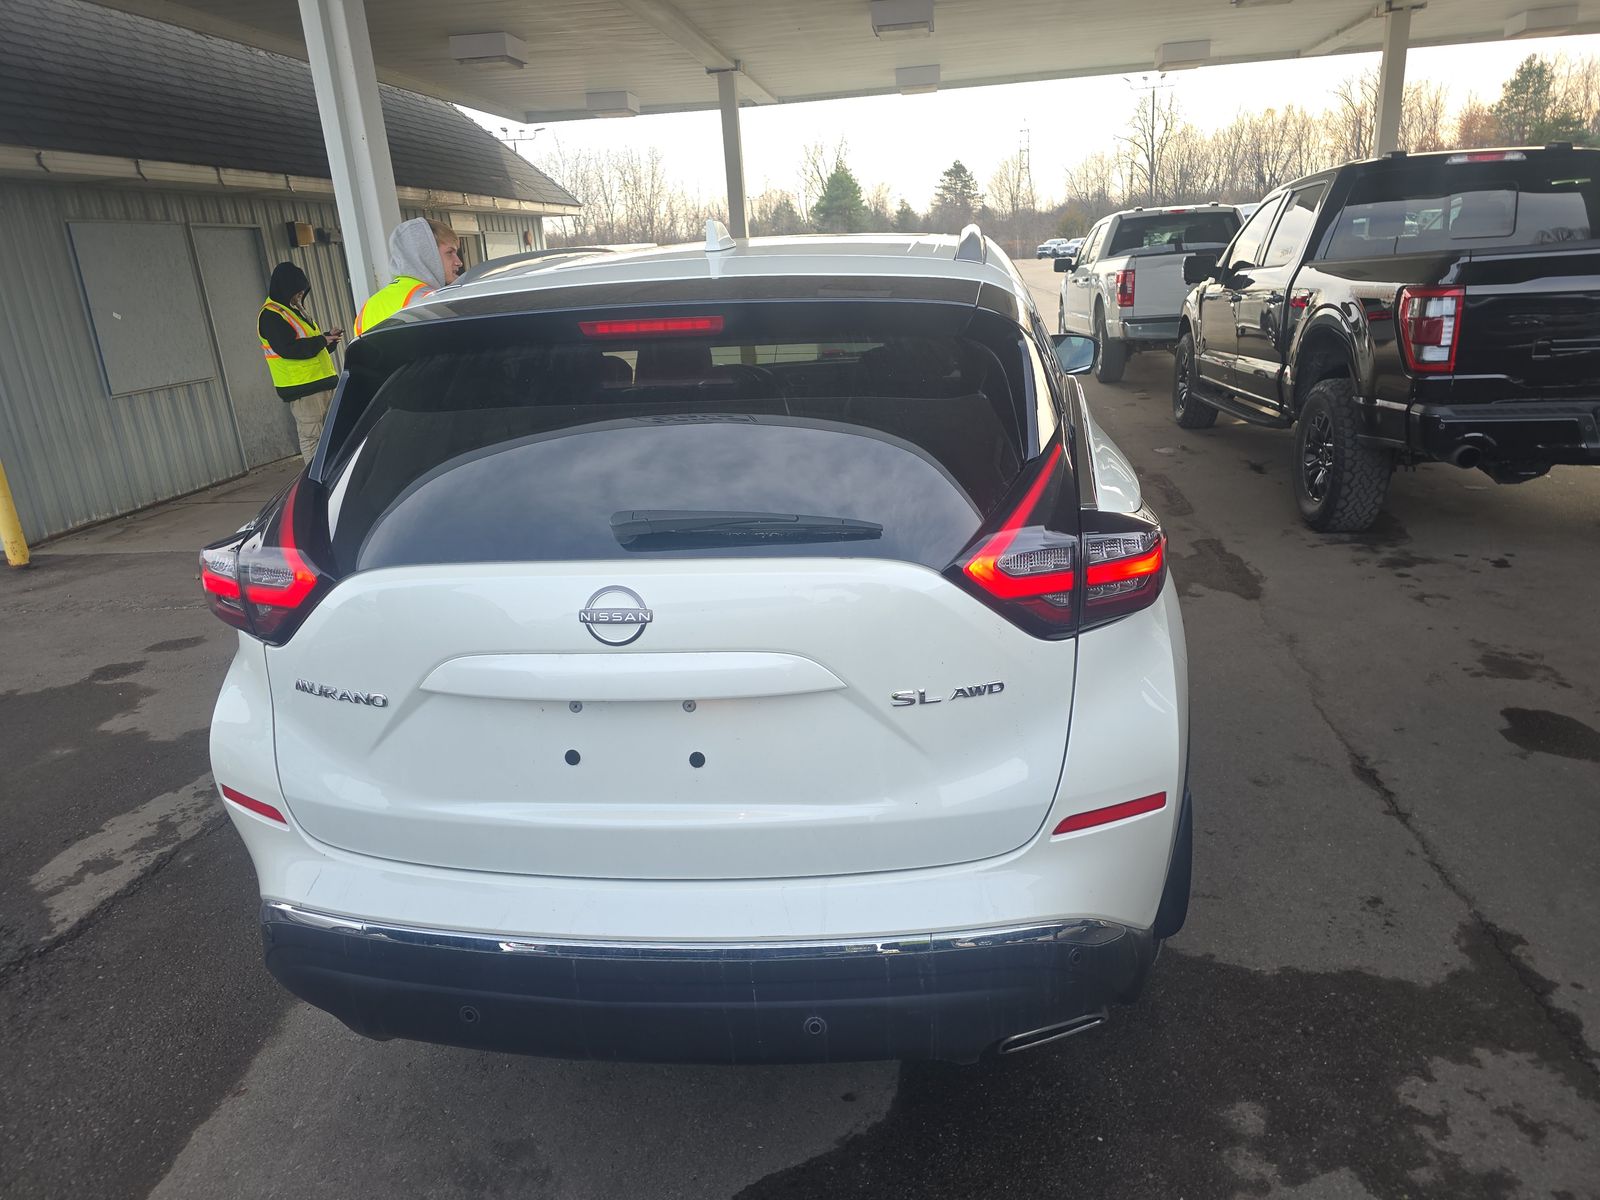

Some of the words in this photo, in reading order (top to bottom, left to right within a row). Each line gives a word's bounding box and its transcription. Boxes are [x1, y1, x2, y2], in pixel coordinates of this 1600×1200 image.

[580, 611, 651, 622] NISSAN
[295, 679, 389, 708] MURANO
[891, 688, 942, 707] SL
[949, 680, 1005, 701] AWD
